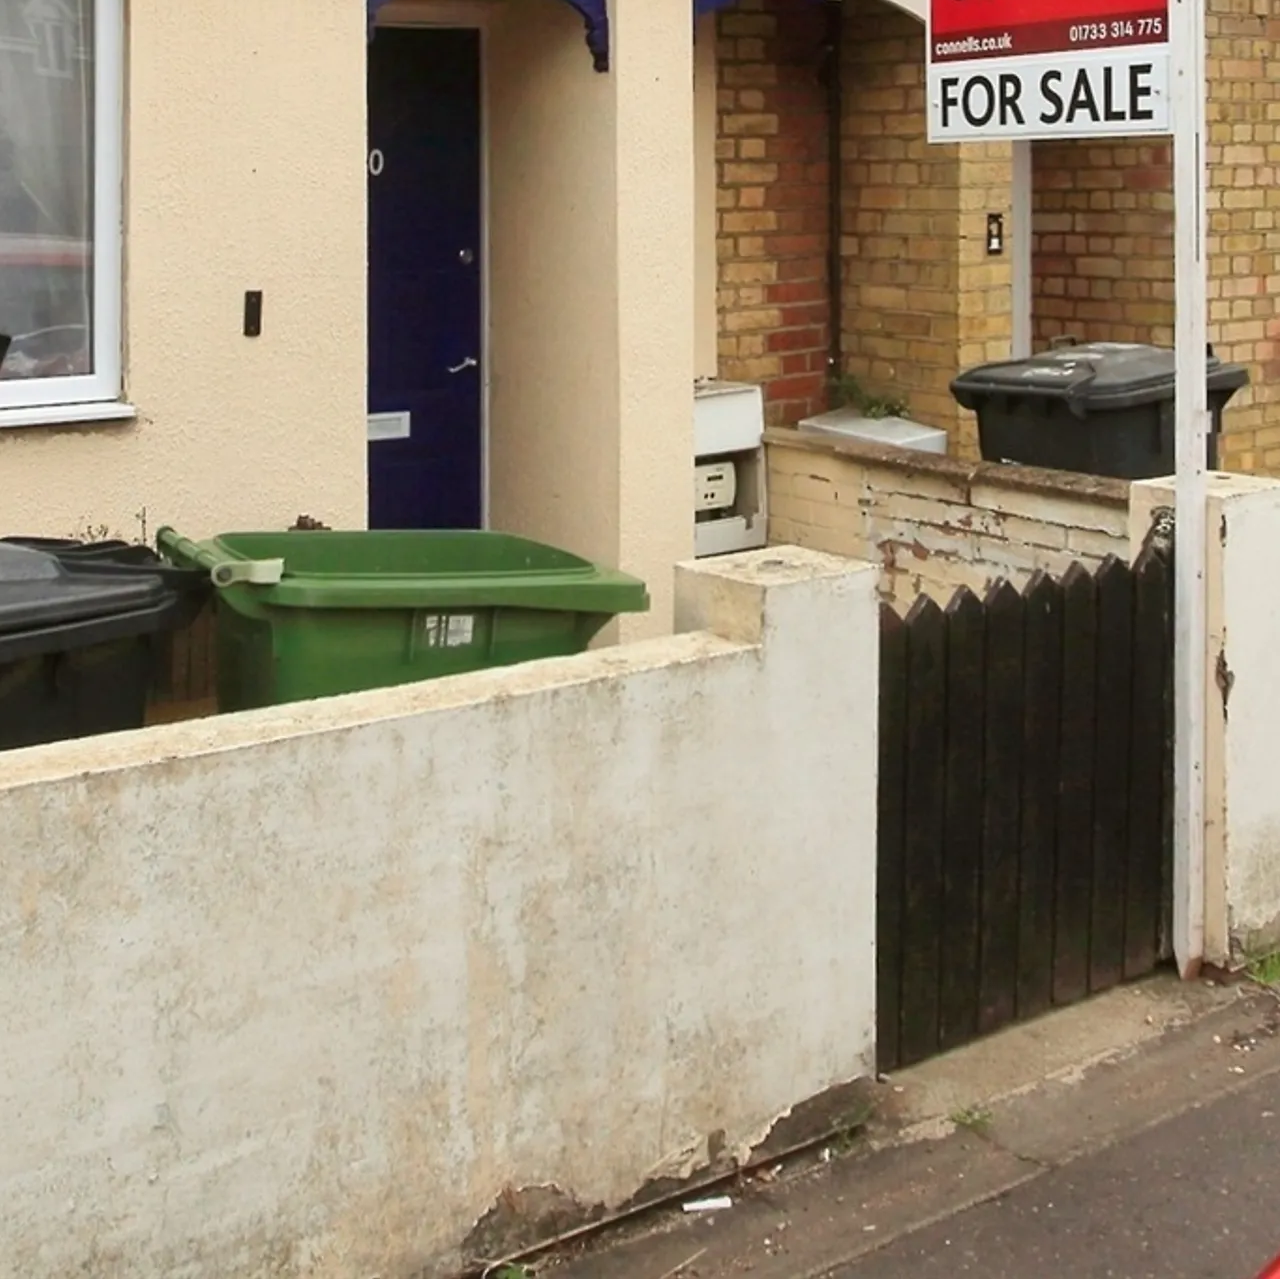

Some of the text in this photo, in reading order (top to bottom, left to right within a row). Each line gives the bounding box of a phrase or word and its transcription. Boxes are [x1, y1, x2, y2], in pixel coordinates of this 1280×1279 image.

[1070, 18, 1162, 41] 01733 314 775
[935, 32, 1012, 55] connells.co.uk
[940, 64, 1154, 128] FOR SALE
[369, 148, 384, 176] 0
